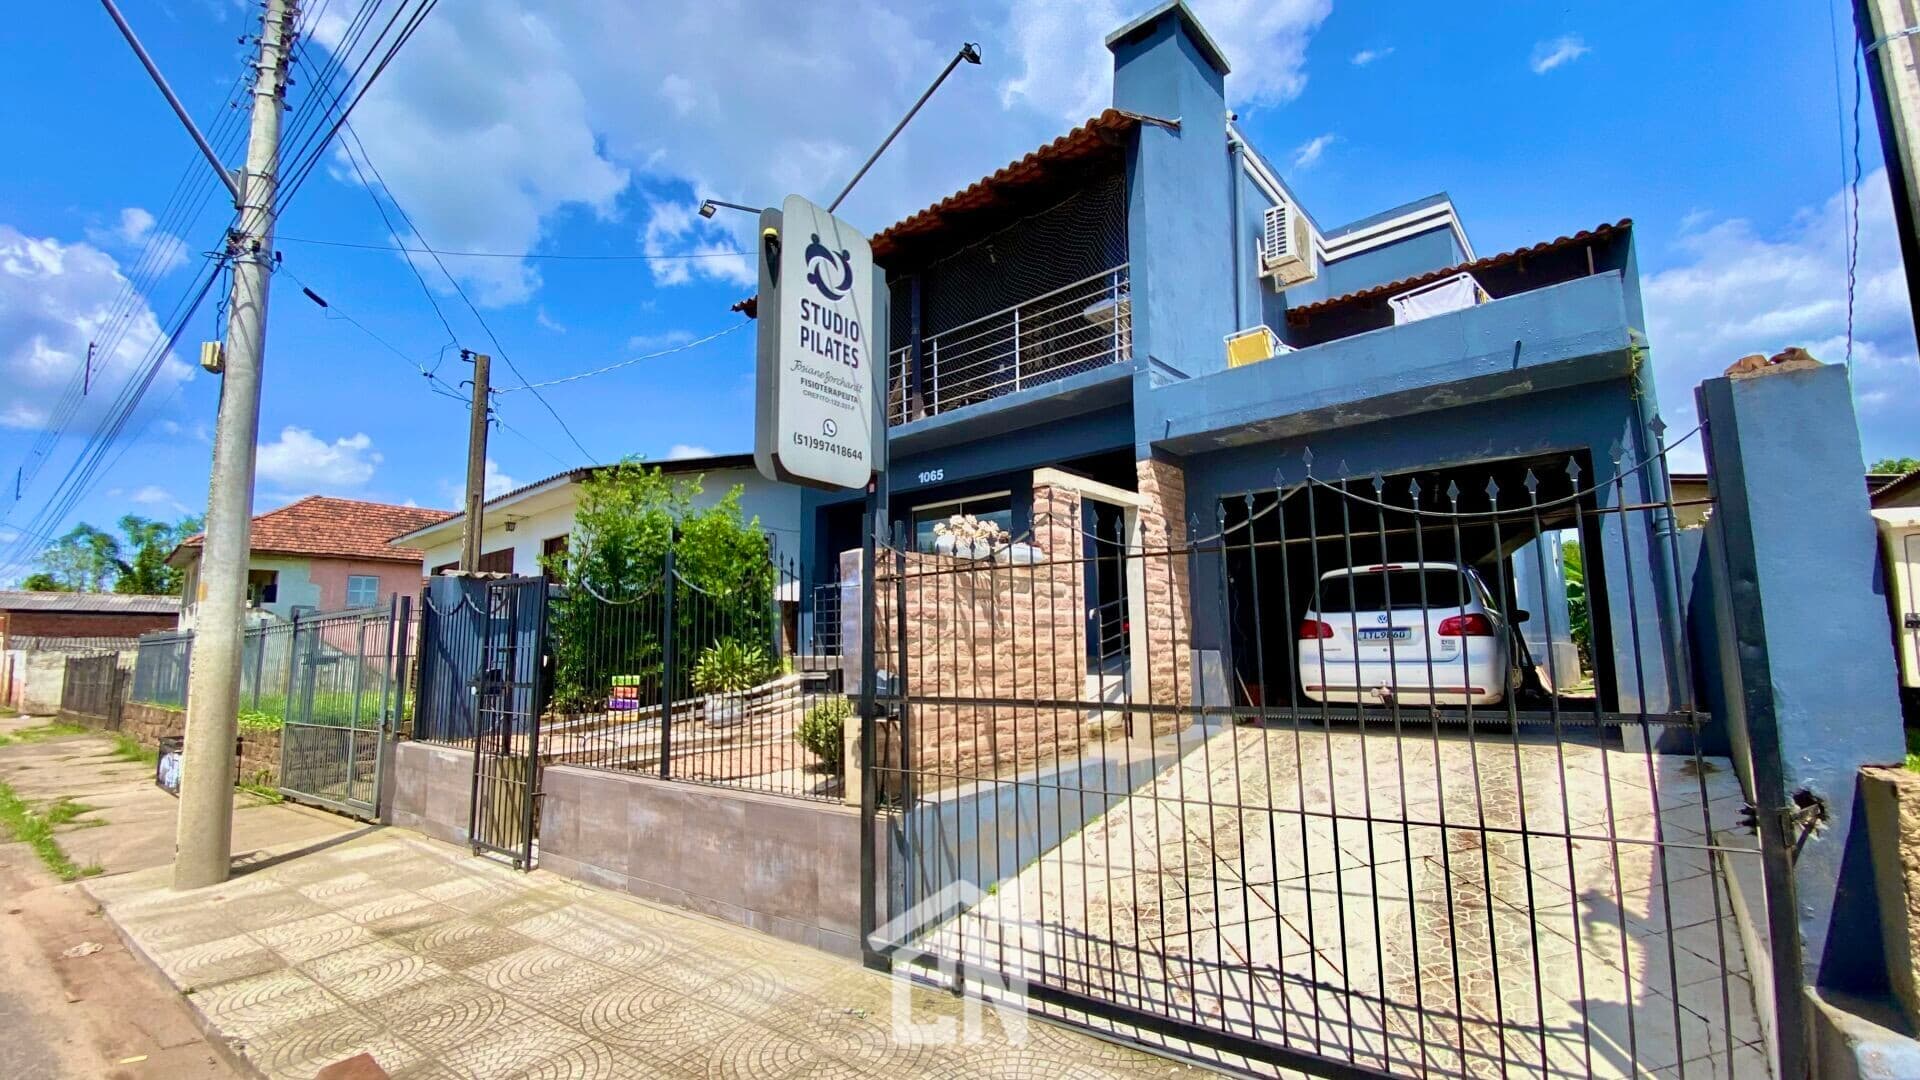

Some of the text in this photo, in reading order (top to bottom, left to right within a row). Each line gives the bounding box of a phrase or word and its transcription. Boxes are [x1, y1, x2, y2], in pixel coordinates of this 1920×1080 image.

[800, 298, 860, 343] STUDIO
[800, 325, 860, 369] PILATES
[800, 377, 859, 403] FISIOTERAPEUTA
[793, 431, 863, 461] (51)997418644
[918, 468, 944, 484] 1065
